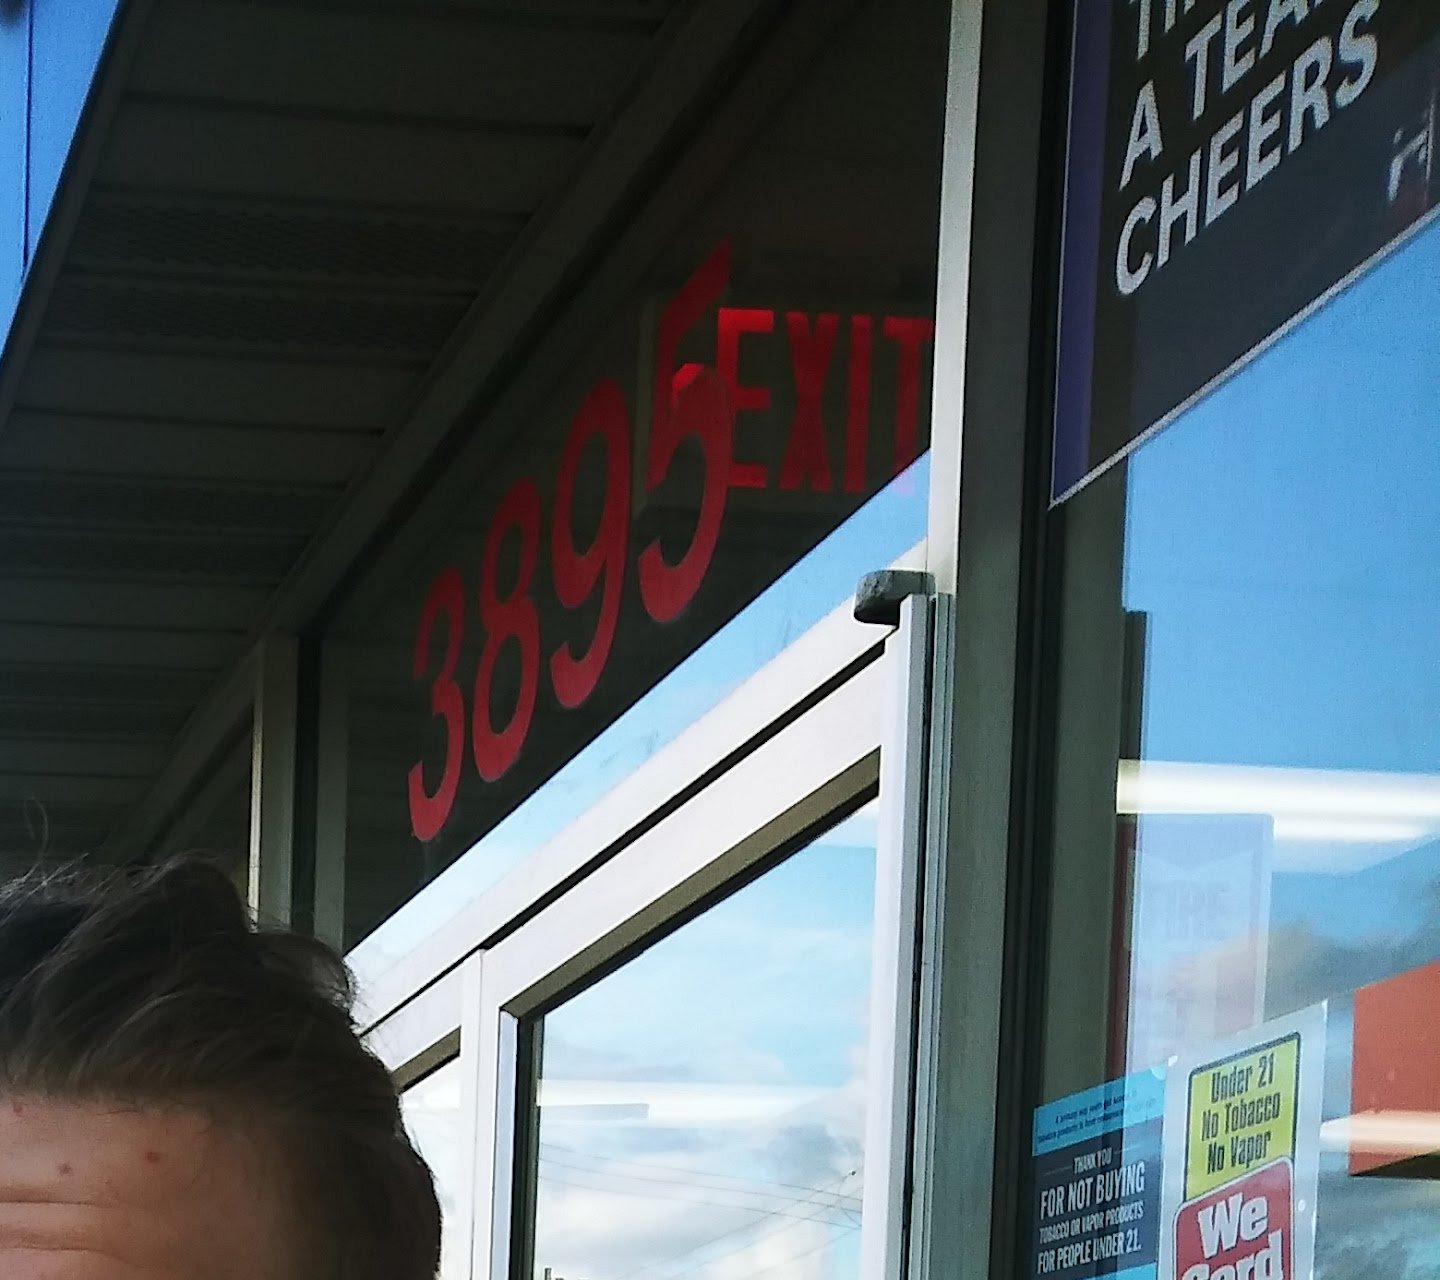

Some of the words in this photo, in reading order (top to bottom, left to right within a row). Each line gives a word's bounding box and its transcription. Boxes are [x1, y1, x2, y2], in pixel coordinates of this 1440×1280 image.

[1119, 79, 1163, 192] A
[1184, 0, 1324, 120] TEA
[1114, 0, 1380, 296] CHEERS
[717, 308, 936, 495] EXIT
[407, 238, 735, 842] 3895
[1211, 1066, 1253, 1104] Under
[1258, 1052, 1274, 1089] 21
[1202, 1109, 1219, 1141] No
[1224, 1092, 1280, 1135] Tobacco
[1073, 1154, 1097, 1174] THANK
[1097, 1147, 1113, 1168] YOU
[1207, 1142, 1225, 1175] No
[1230, 1131, 1271, 1169] Vapor
[1040, 1185, 1066, 1220] FOR
[1068, 1177, 1093, 1213] NOT
[1095, 1160, 1146, 1205] BUYING
[1037, 1248, 1056, 1274] FOR
[1056, 1240, 1092, 1270] PEOPLE
[1092, 1231, 1125, 1261] UNDER
[1125, 1227, 1142, 1254] 21.
[1039, 1220, 1070, 1245] TOBACCO
[1070, 1218, 1081, 1237] OR
[1081, 1211, 1105, 1233] VAPOR
[1105, 1200, 1144, 1226] PRODUCTS
[1197, 1191, 1269, 1260] We
